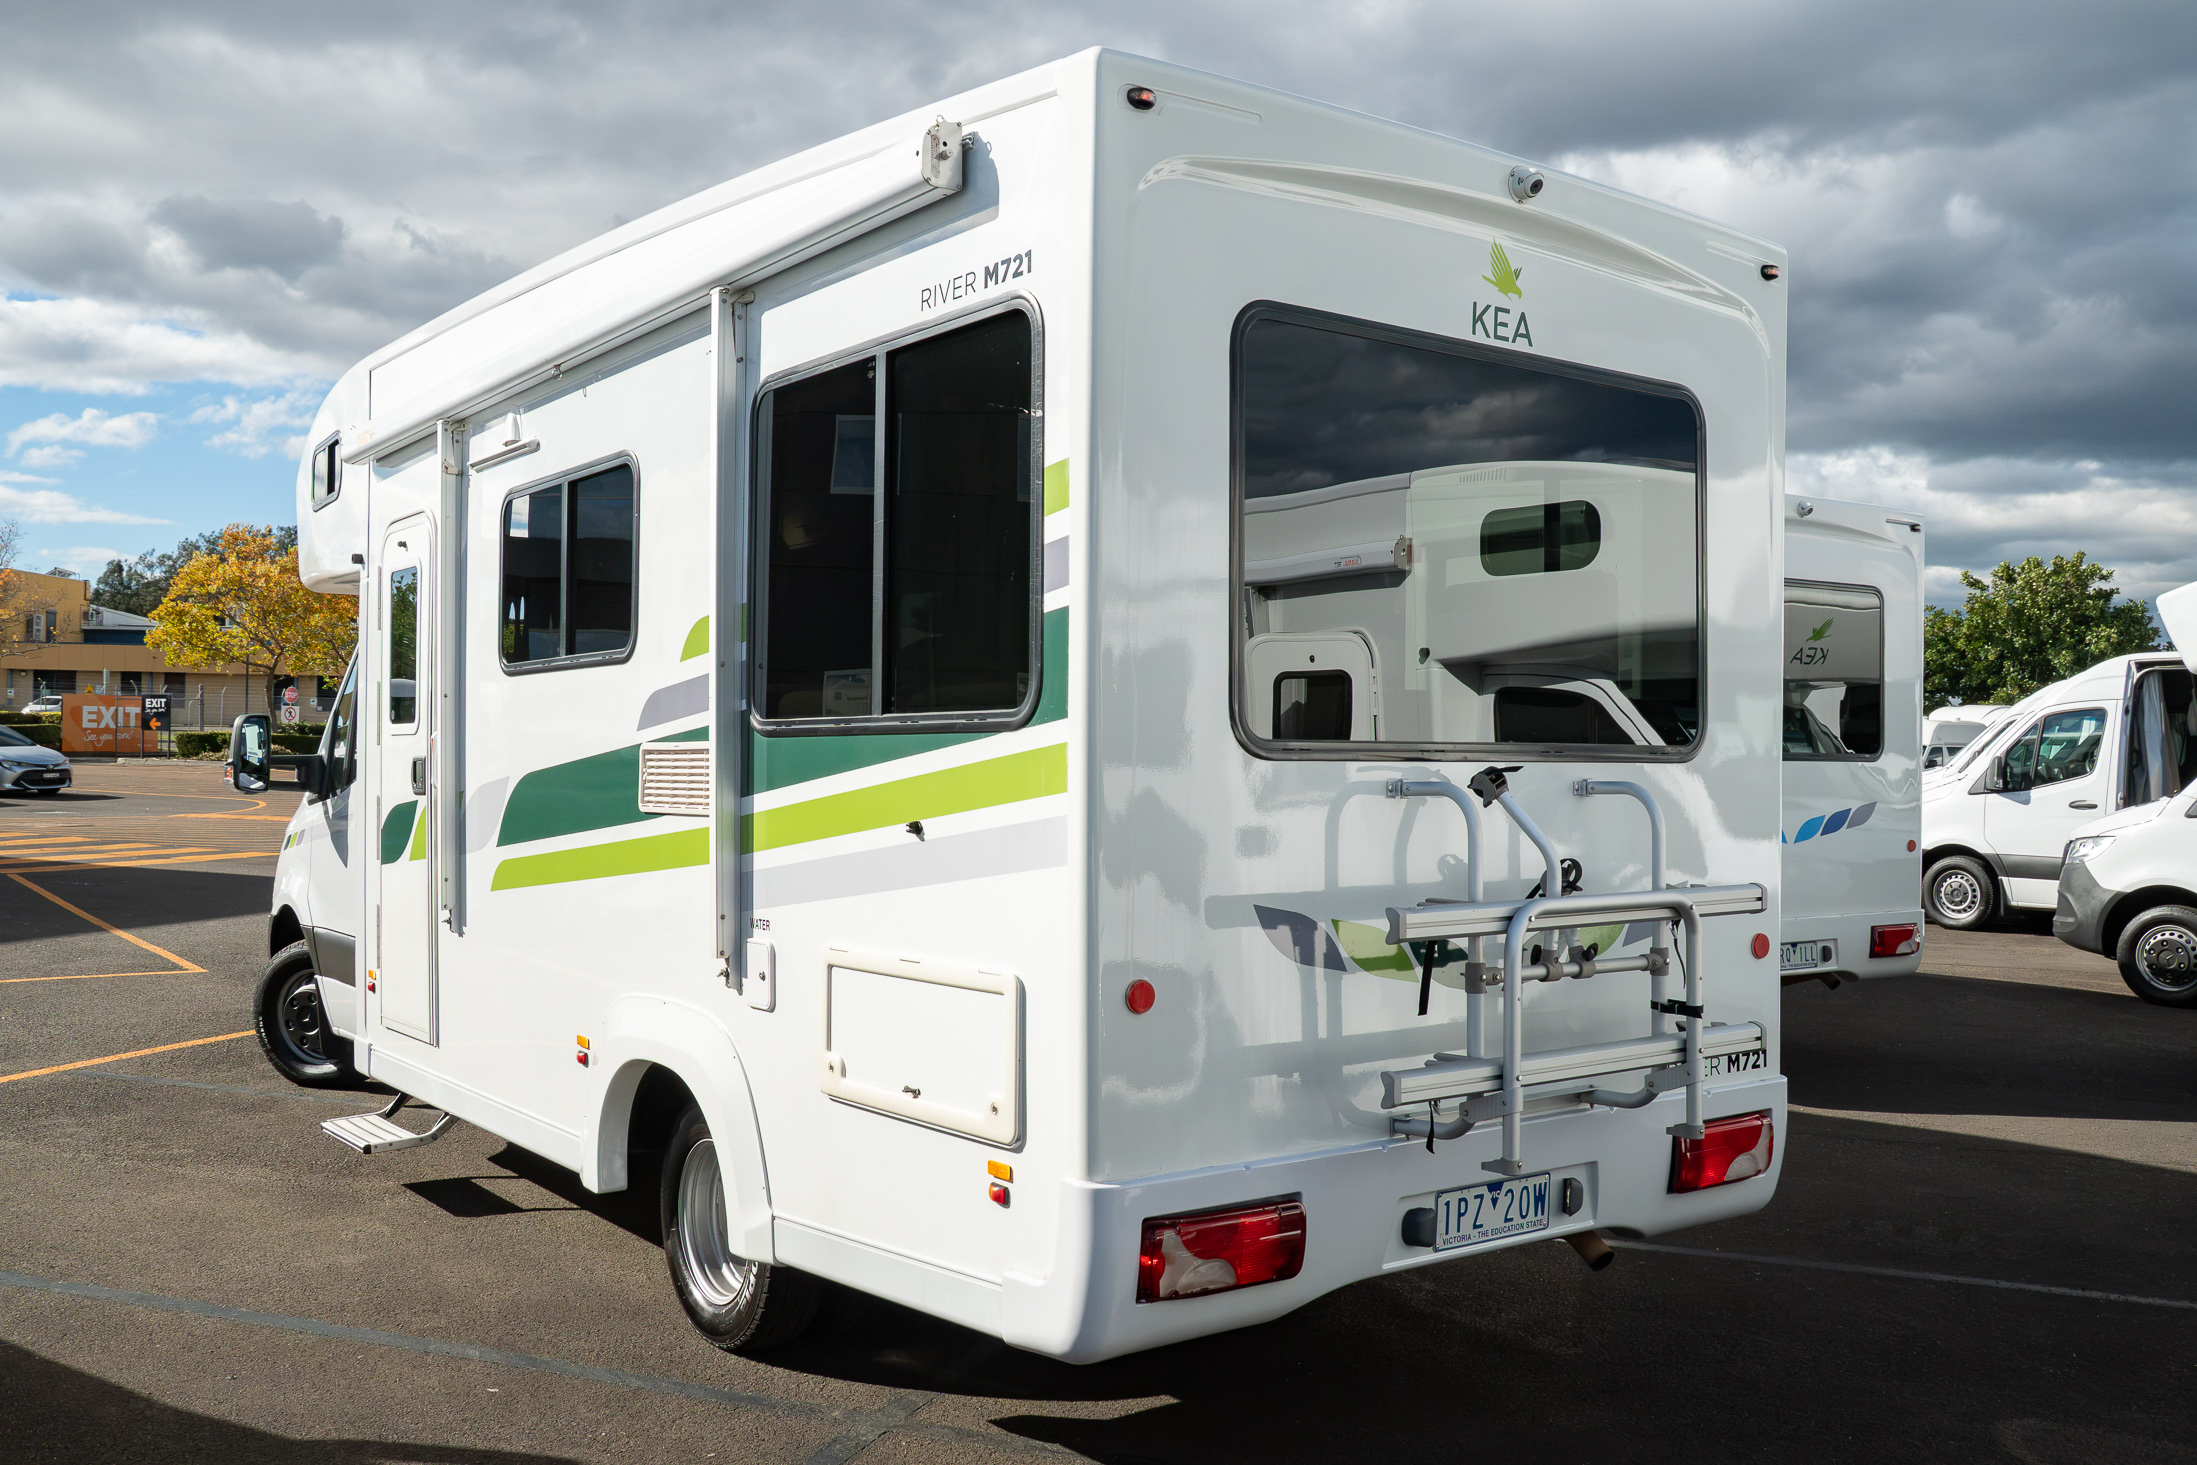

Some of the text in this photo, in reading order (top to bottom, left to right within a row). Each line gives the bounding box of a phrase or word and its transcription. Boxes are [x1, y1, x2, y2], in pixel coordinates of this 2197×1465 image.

[921, 249, 1032, 312] RIVER M721
[1472, 301, 1533, 347] KEA
[145, 698, 167, 708] EXIT
[285, 691, 298, 700] STOP
[82, 705, 141, 729] EXIT
[83, 730, 97, 741] See
[95, 734, 113, 747] you
[750, 917, 771, 931] WATER
[1727, 1050, 1767, 1074] M721
[1444, 1193, 1485, 1236] 1PZ
[1442, 1233, 1472, 1246] VICTORIA
[1477, 1230, 1490, 1239] THE
[1491, 1223, 1525, 1236] EDUCATION
[1526, 1219, 1543, 1229] STATE
